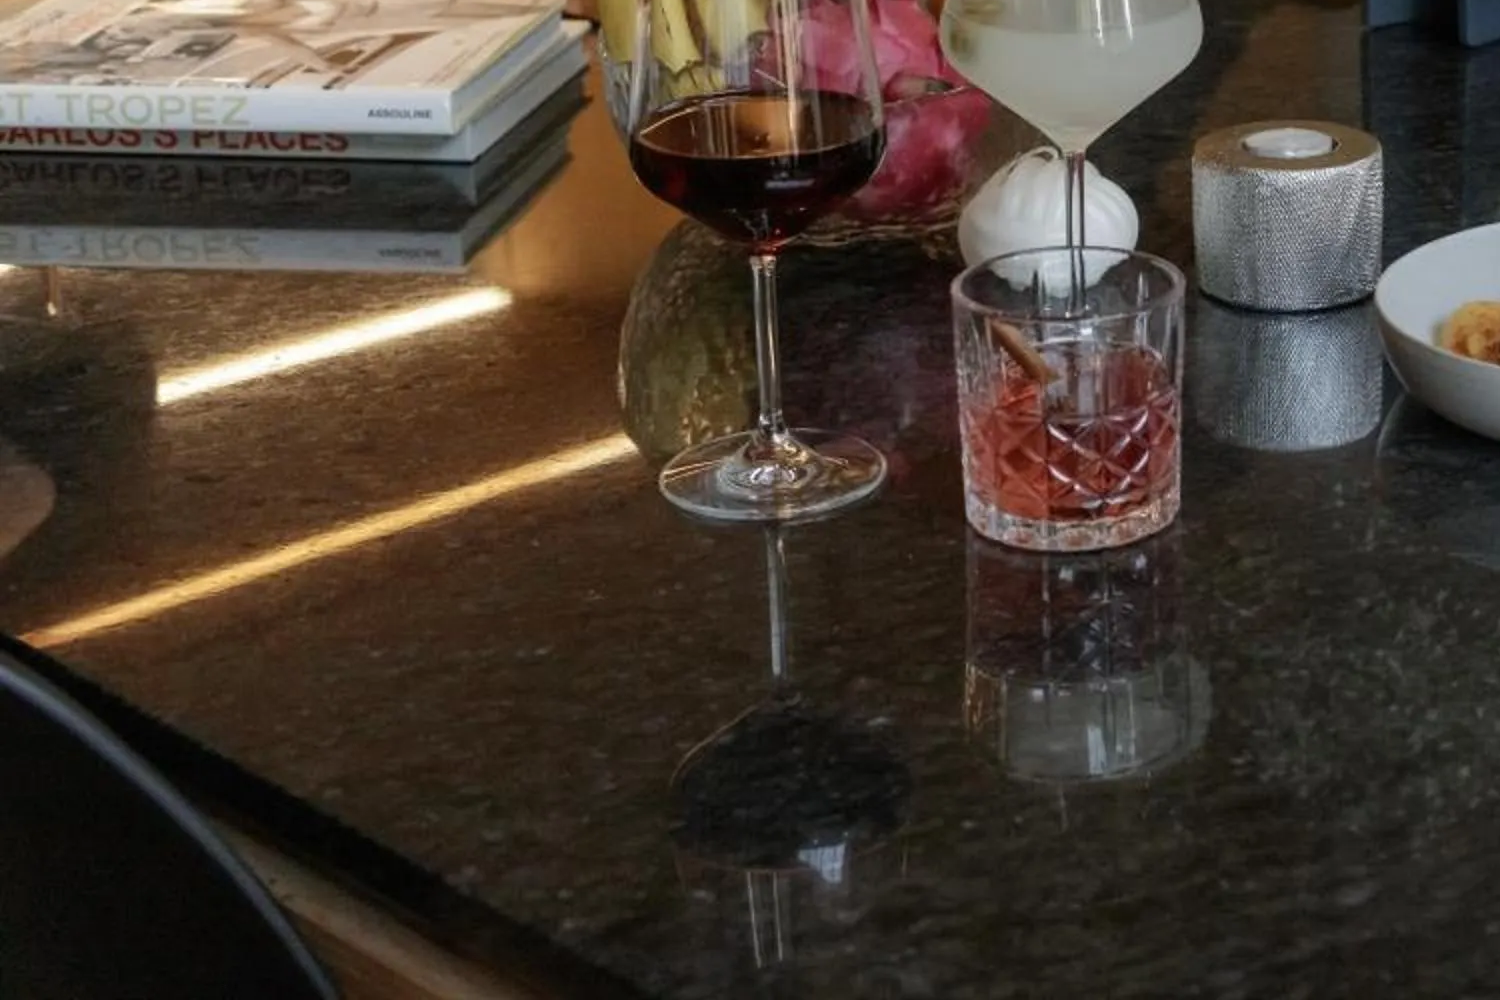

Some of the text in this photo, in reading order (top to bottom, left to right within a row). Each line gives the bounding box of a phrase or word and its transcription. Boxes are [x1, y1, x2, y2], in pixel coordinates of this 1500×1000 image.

[0, 92, 250, 126] T. TROPEZ
[192, 130, 349, 152] PLACES
